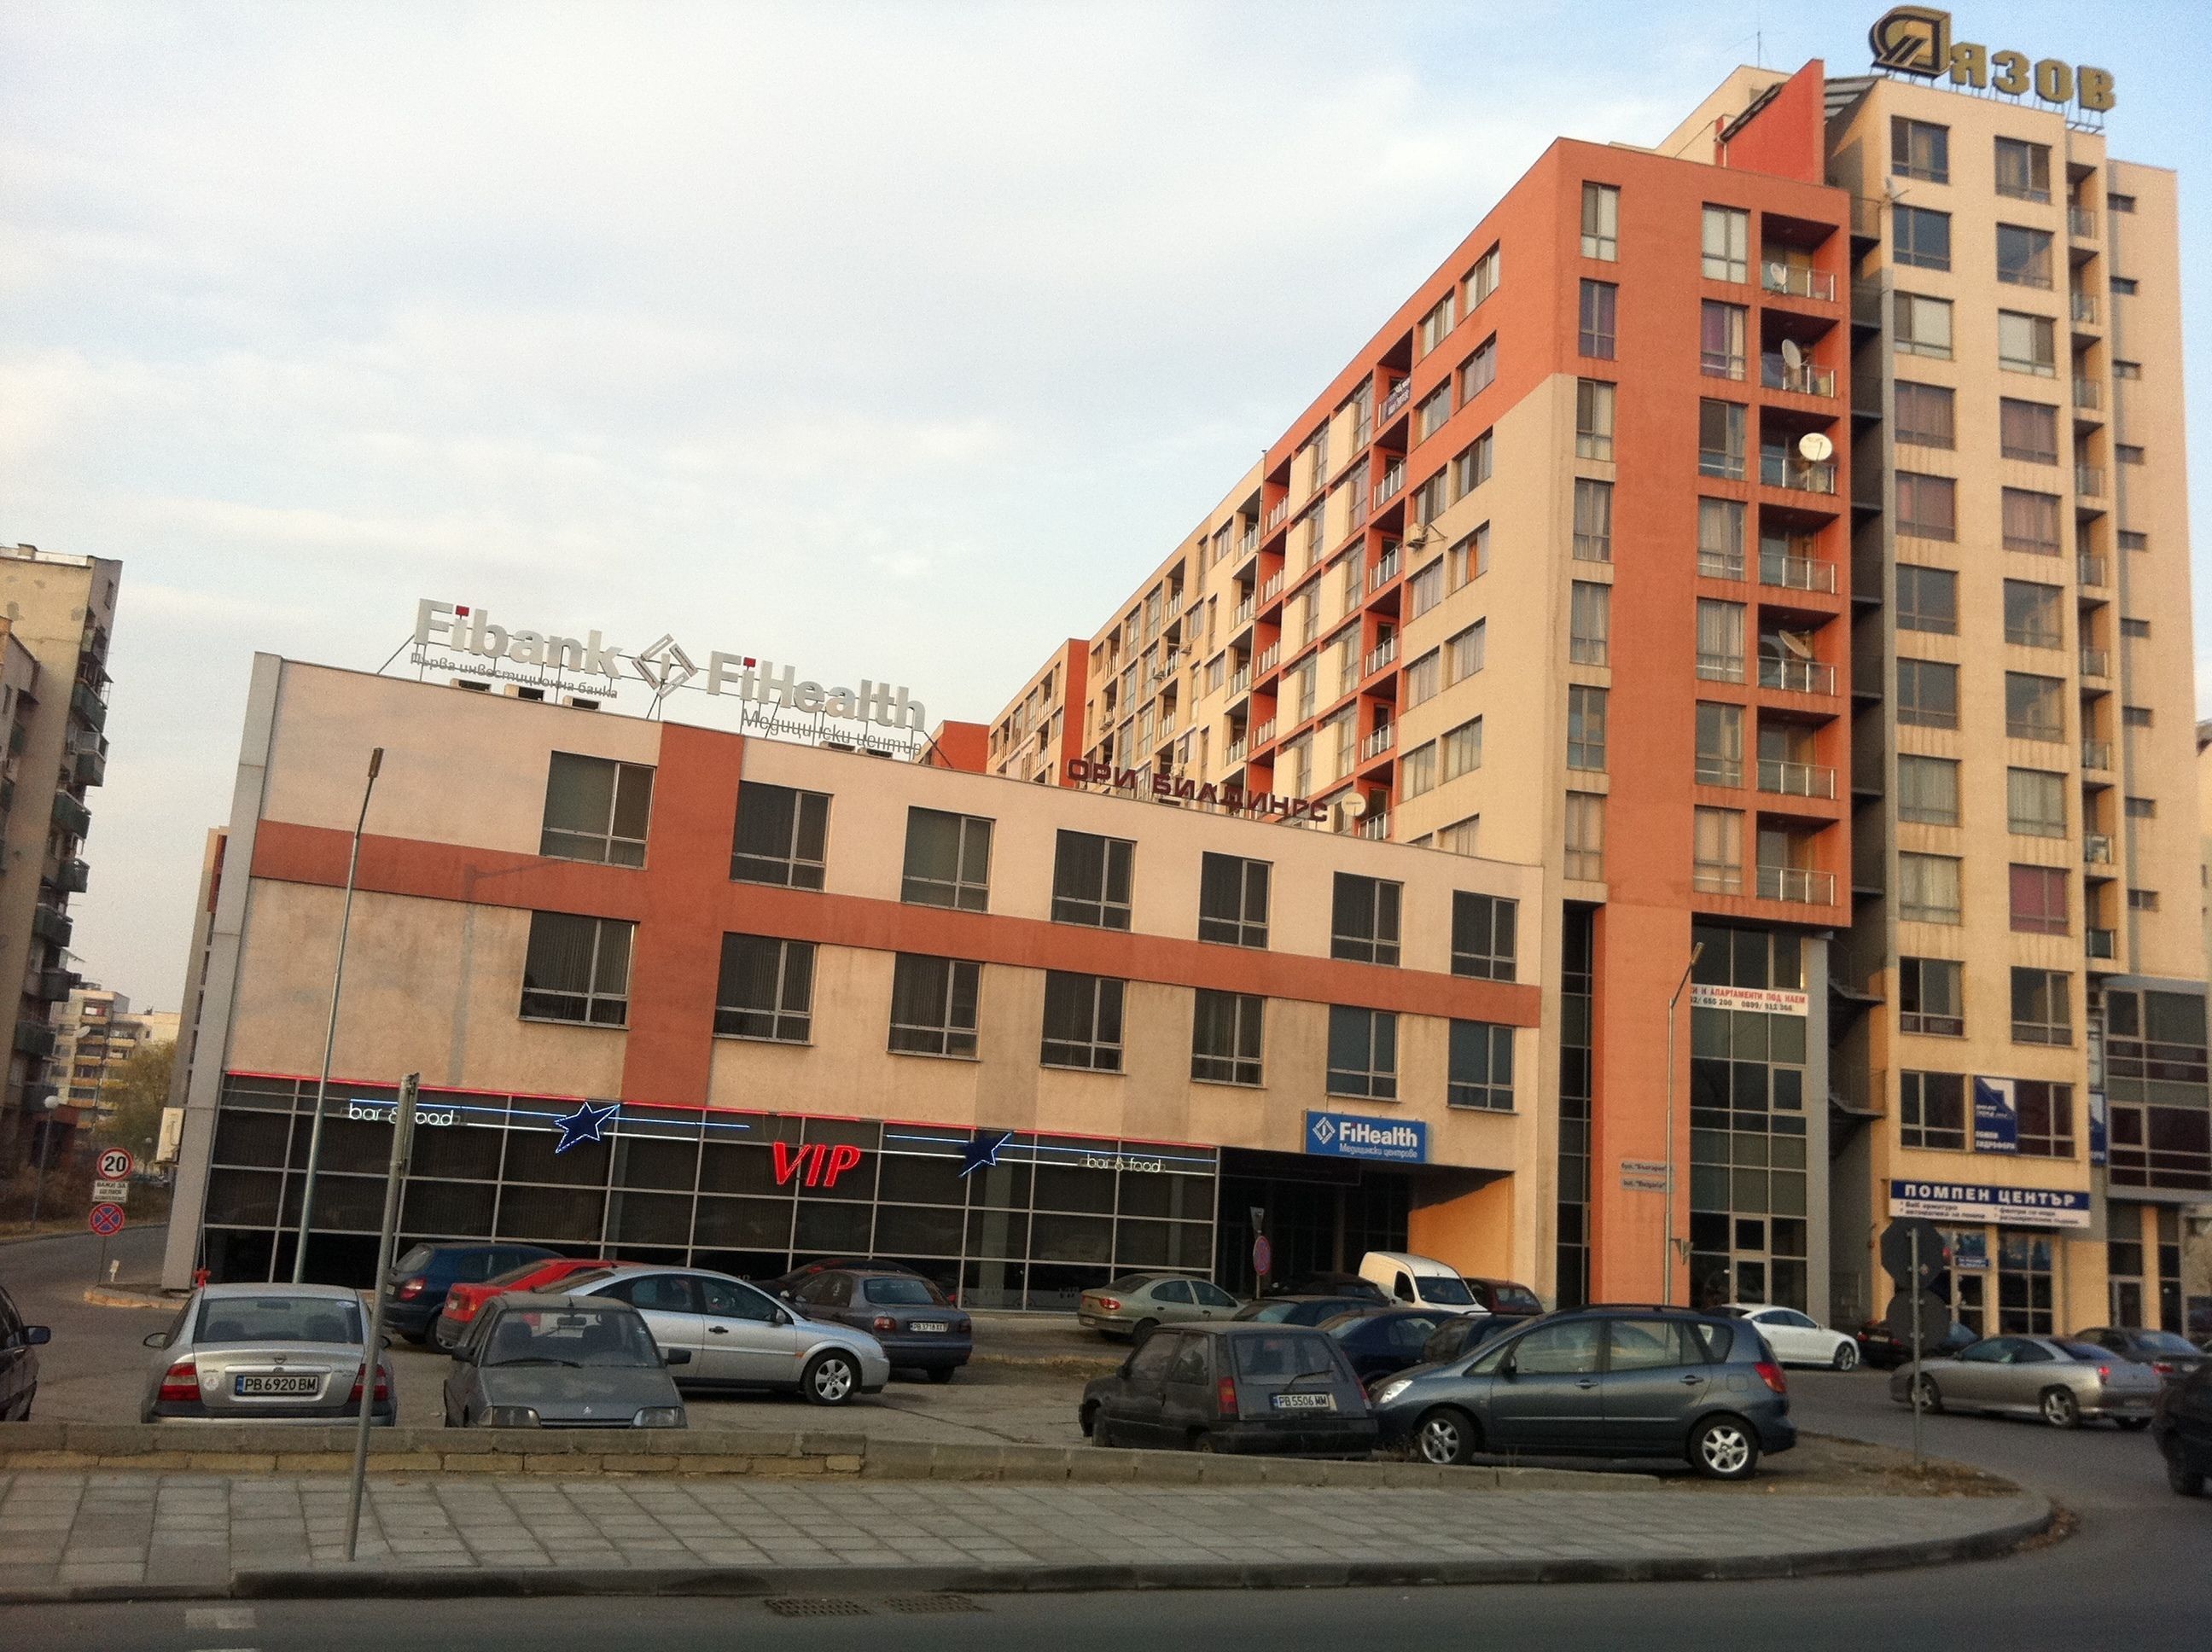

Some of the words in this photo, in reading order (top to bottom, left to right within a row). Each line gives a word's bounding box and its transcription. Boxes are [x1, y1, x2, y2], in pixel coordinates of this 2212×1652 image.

[414, 597, 624, 680] Fibank
[578, 682, 618, 699] банка
[707, 650, 926, 732] FiHealth
[1067, 758, 1136, 788] ОРИ
[1153, 772, 1328, 823] БИЛДИНГС
[1710, 989, 1763, 1000] АПАРТАМЕНТИ
[1766, 994, 1782, 1003] ПОД
[1784, 995, 1806, 1004] НАЕМ
[349, 1102, 382, 1120] bar
[415, 1109, 454, 1126] ood
[1339, 1121, 1418, 1148] FiHealth
[104, 1155, 127, 1172] 20
[773, 1141, 861, 1188] VIP
[1086, 1153, 1109, 1169] bar
[1130, 1157, 1161, 1173] food
[1905, 1184, 1990, 1201] ПОМПЕН
[1998, 1190, 2076, 1207] ЦЕНТЪР
